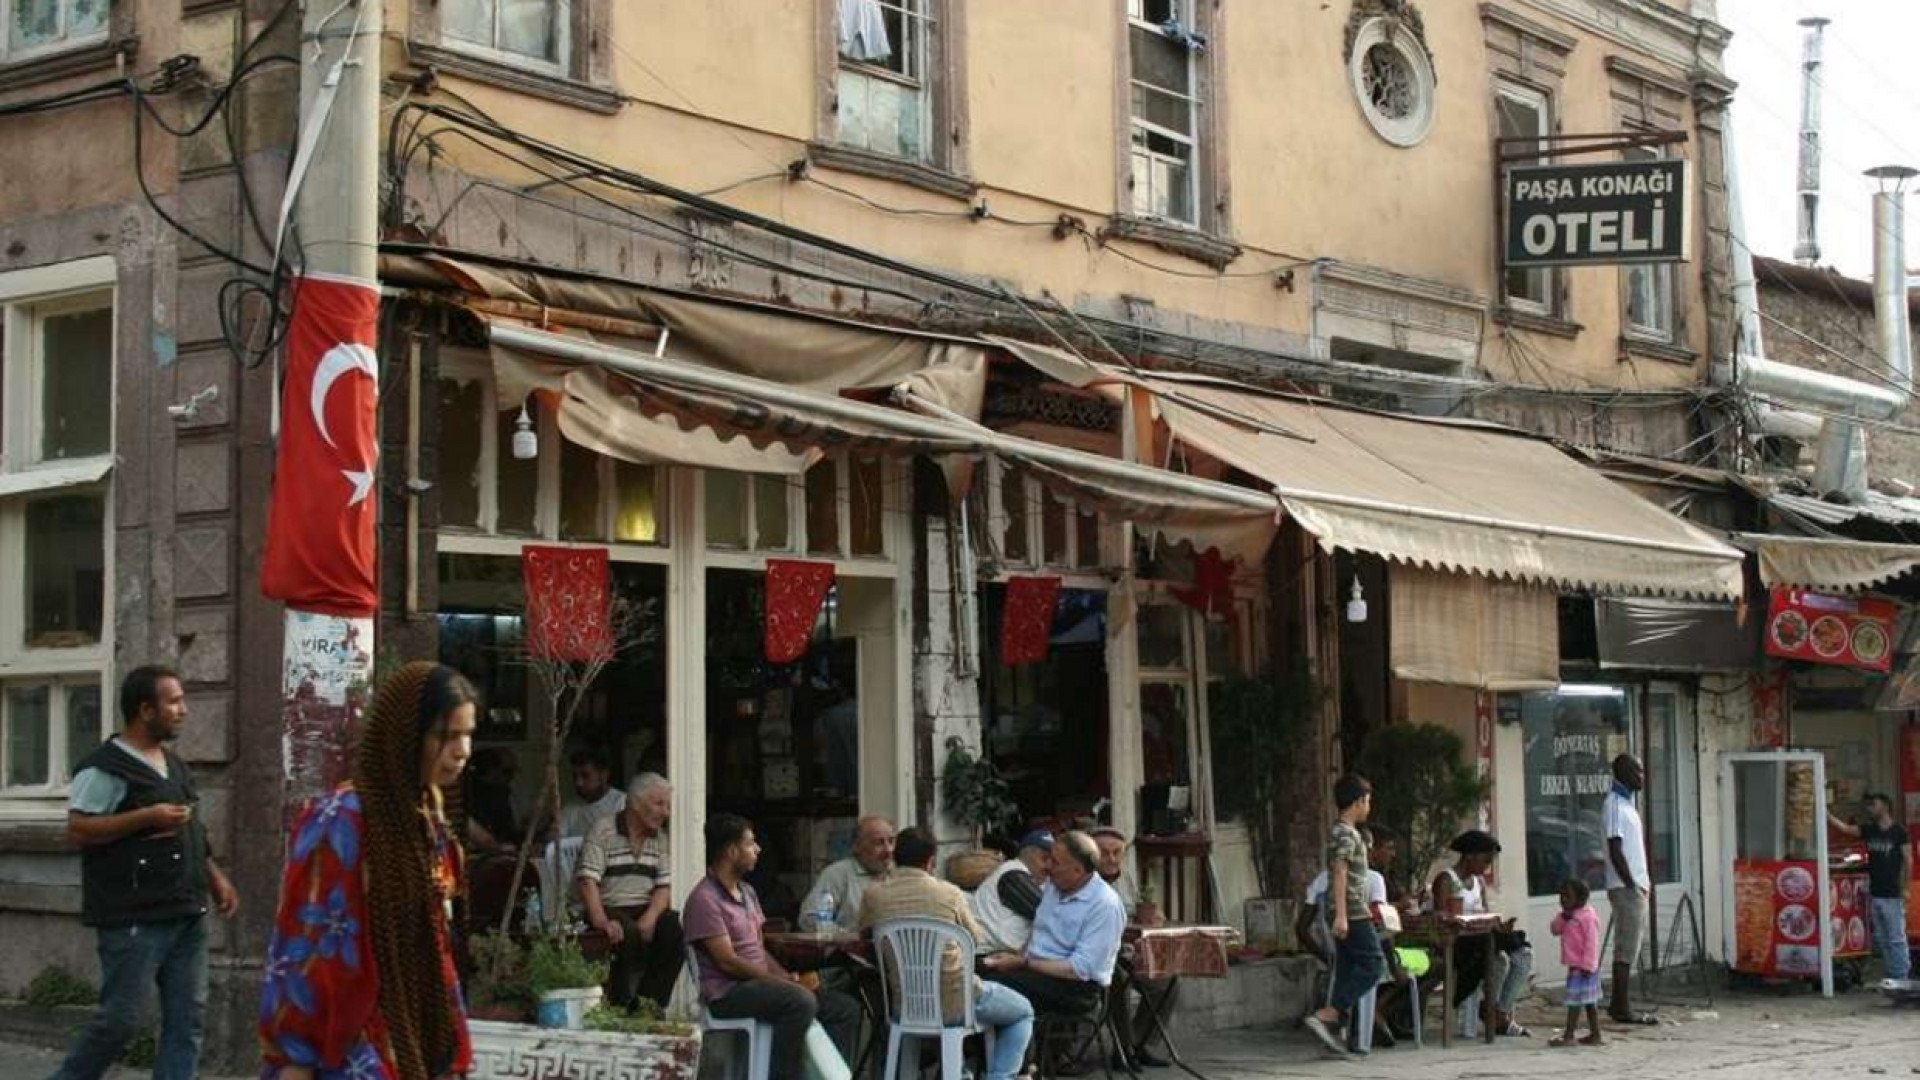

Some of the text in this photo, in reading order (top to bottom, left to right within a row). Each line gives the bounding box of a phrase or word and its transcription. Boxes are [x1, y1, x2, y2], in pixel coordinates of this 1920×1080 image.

[1515, 169, 1673, 203] PAŞA KONAĞI
[1522, 198, 1665, 255] OTELİ
